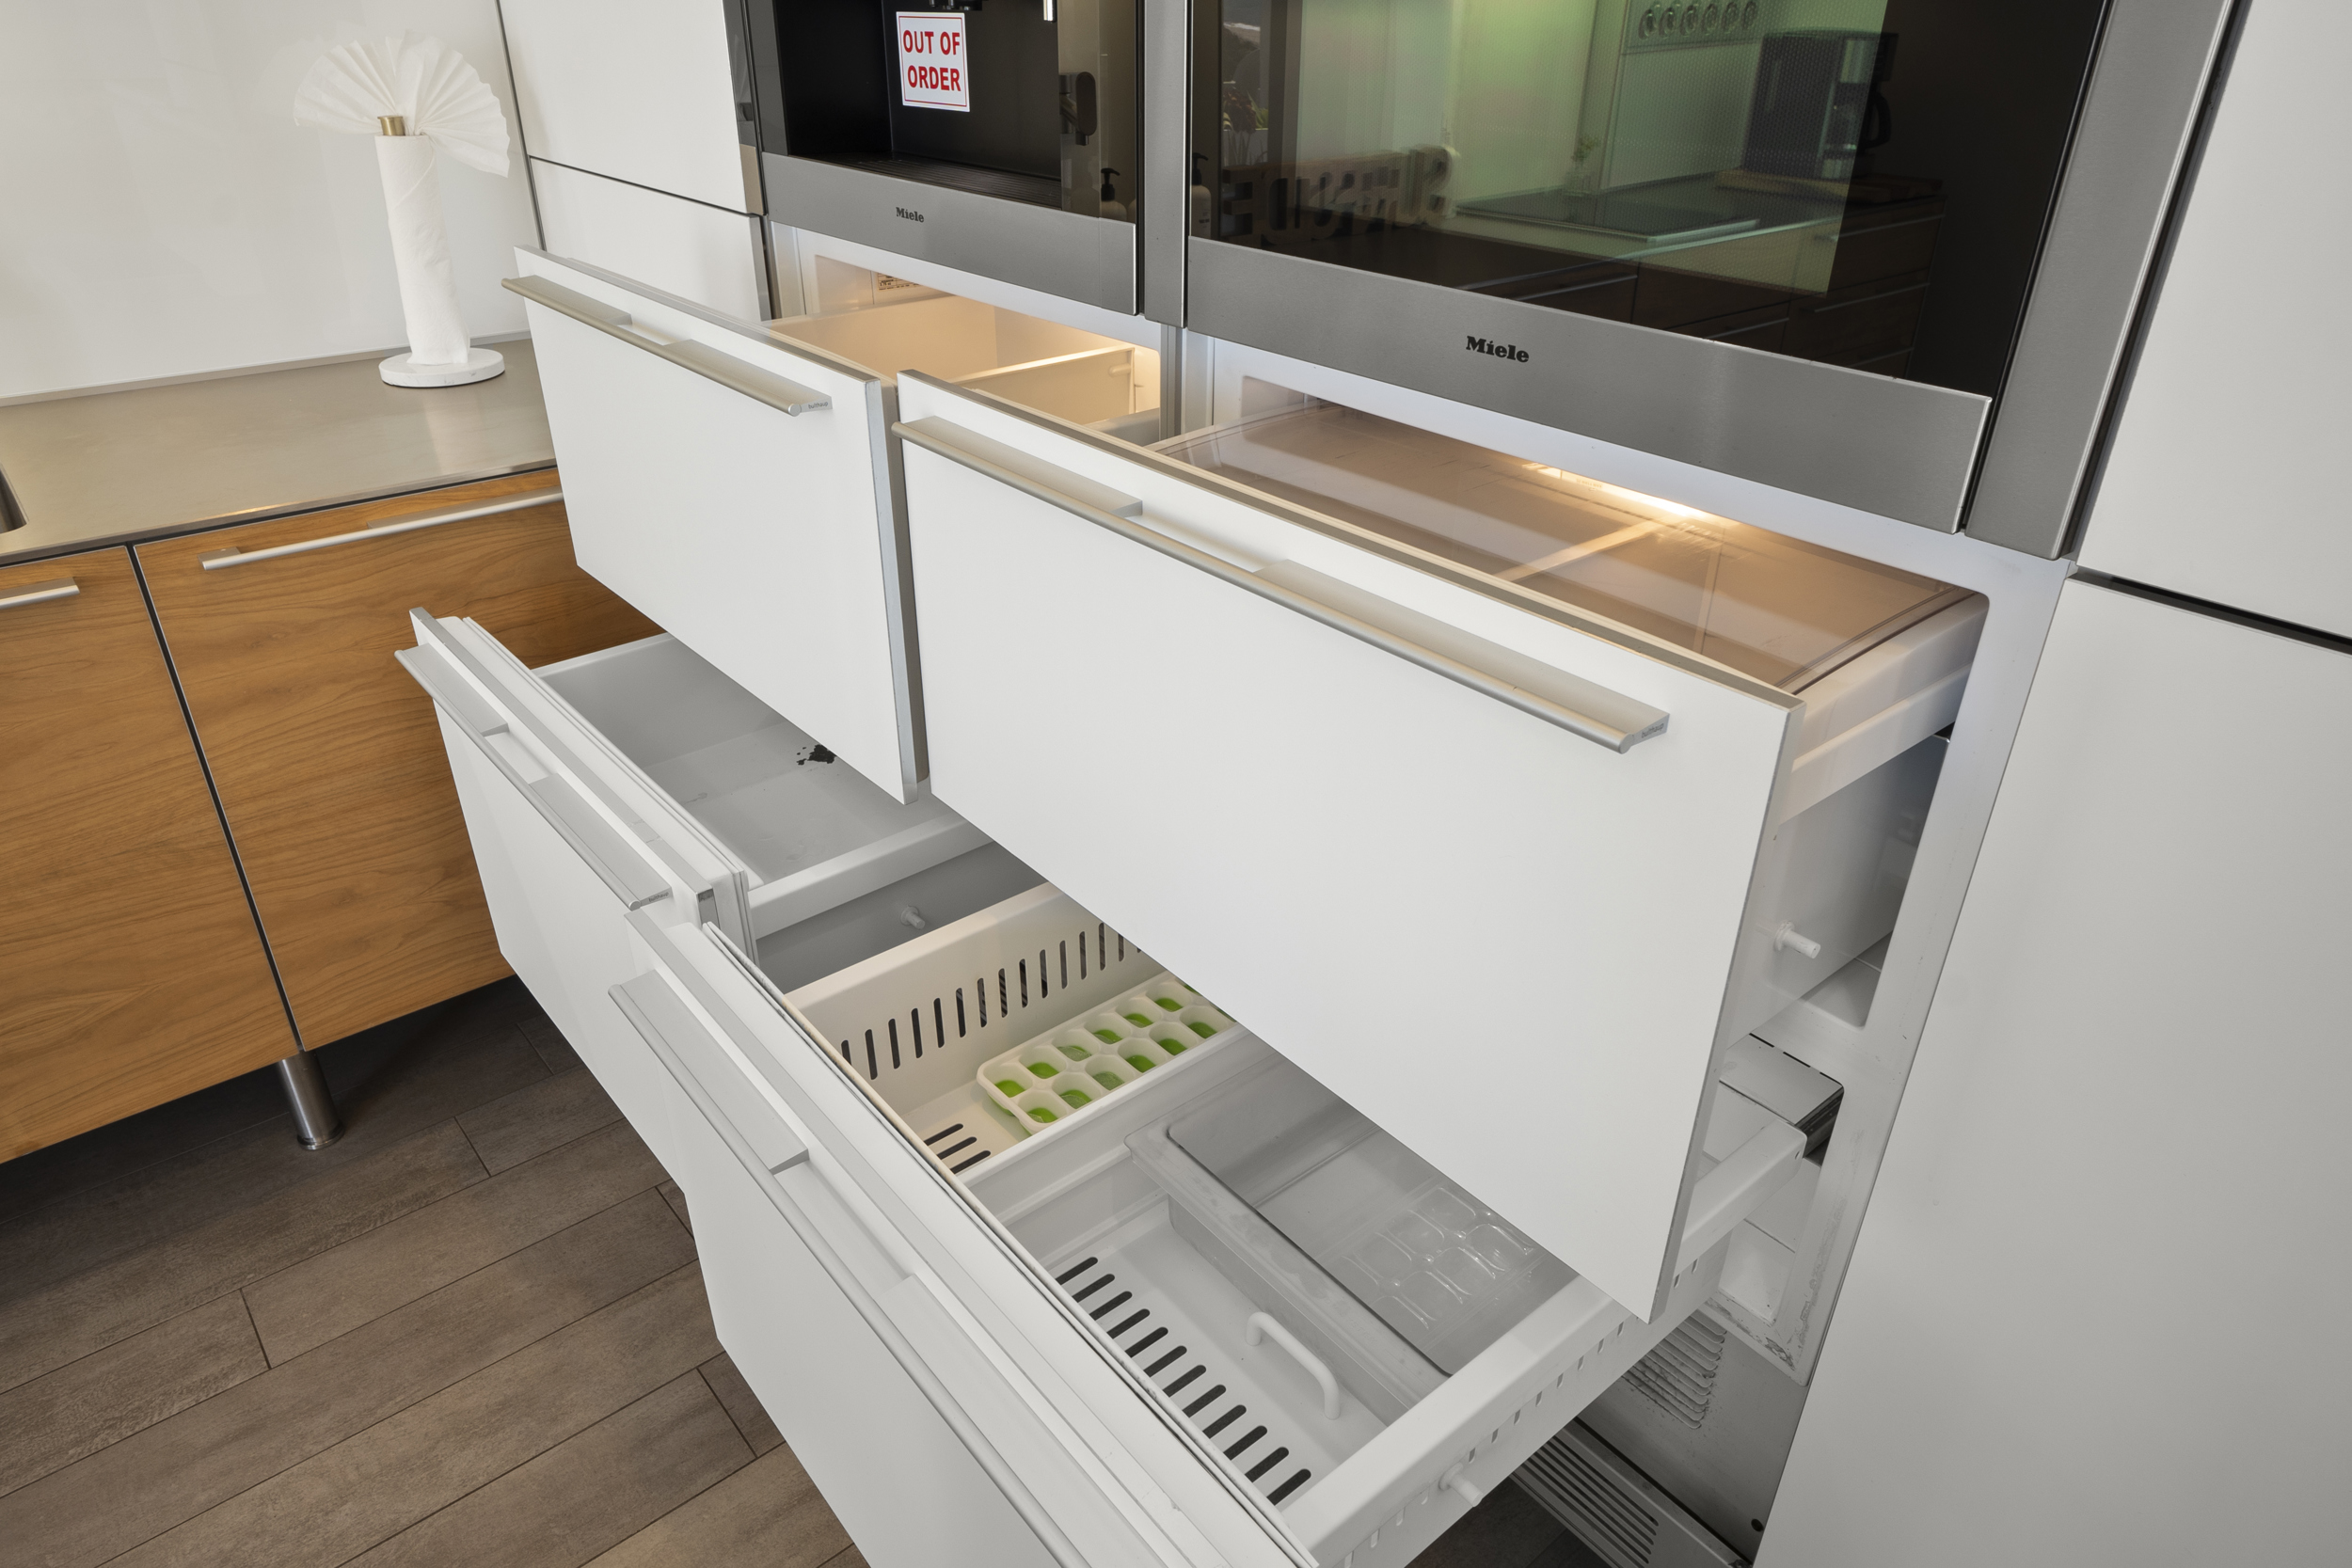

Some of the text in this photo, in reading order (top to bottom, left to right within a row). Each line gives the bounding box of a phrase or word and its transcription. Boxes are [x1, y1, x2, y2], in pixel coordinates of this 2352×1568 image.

[903, 29, 961, 55] OUT OF
[908, 64, 961, 92] ORDER
[896, 206, 925, 223] Miele
[1466, 335, 1530, 363] Miele
